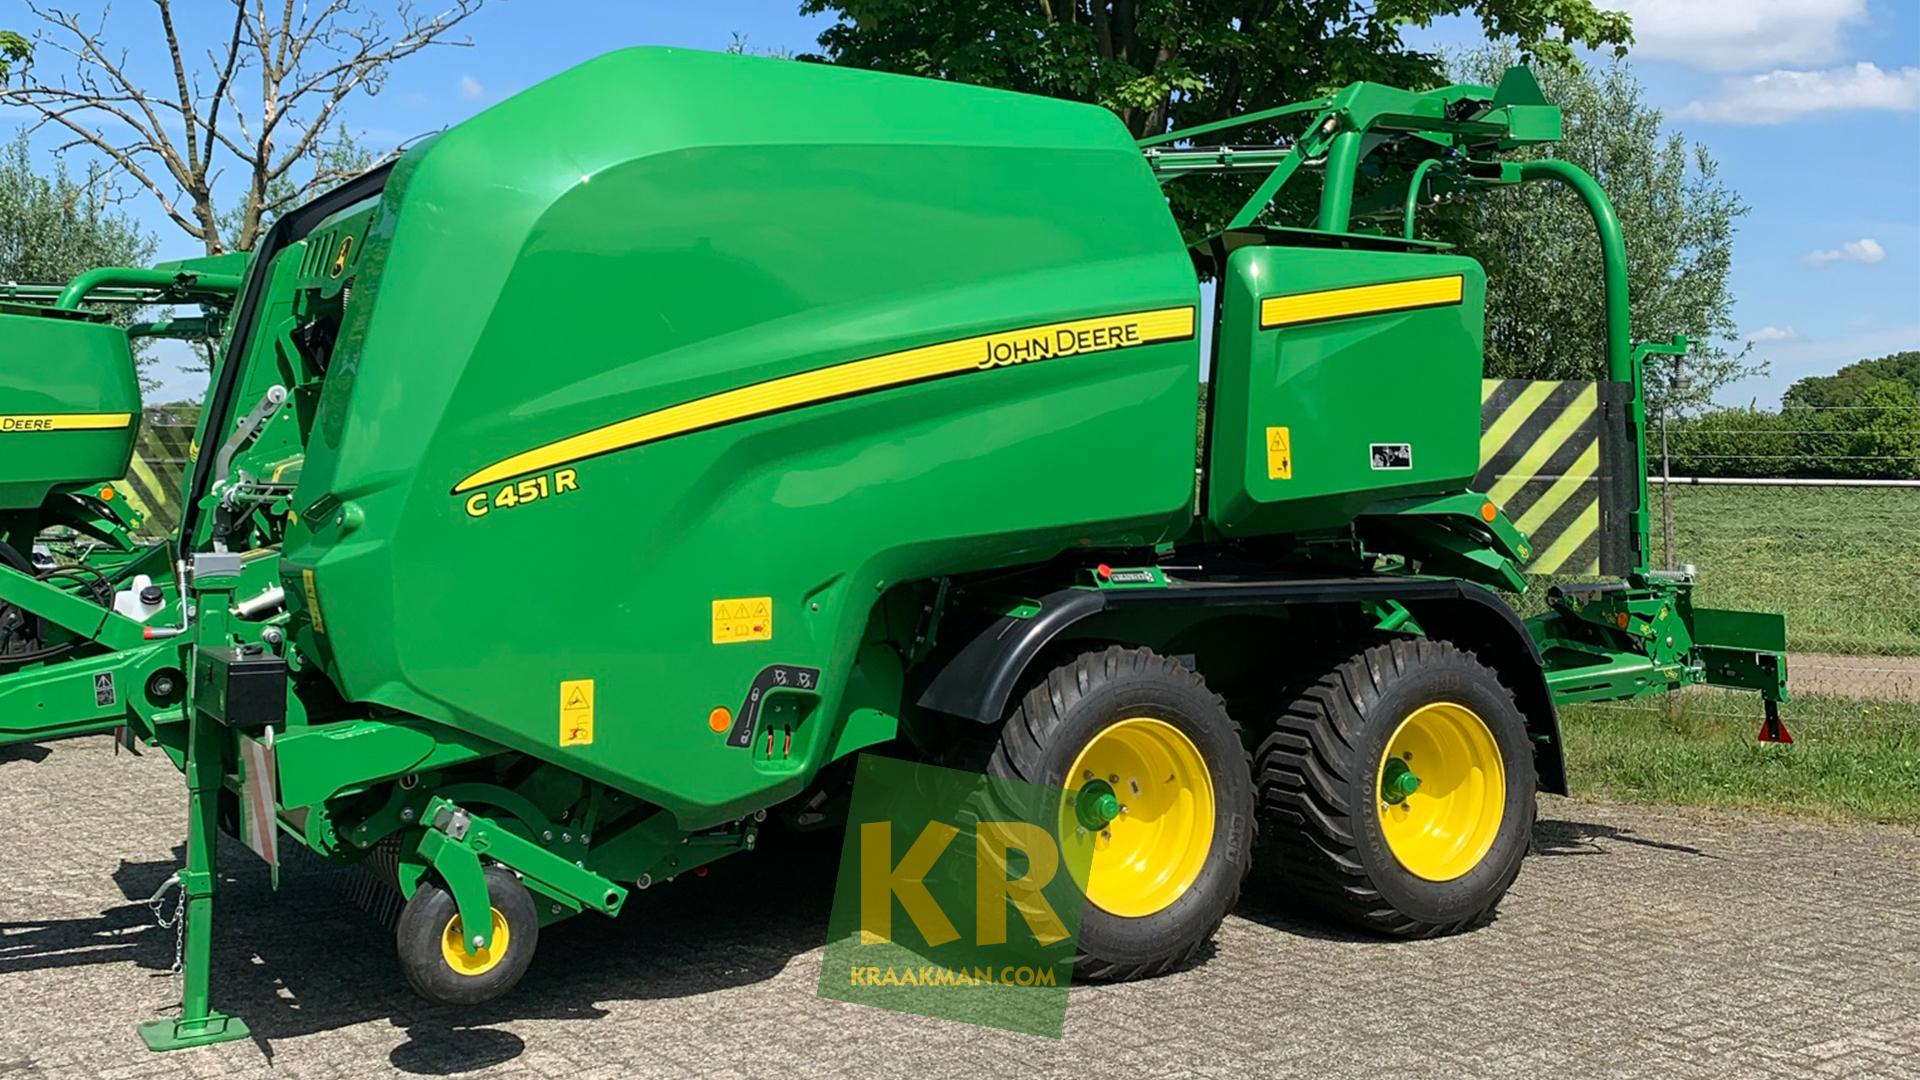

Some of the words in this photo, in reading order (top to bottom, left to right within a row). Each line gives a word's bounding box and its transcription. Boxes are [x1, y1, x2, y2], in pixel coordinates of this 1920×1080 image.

[979, 336, 1050, 366] JOHN
[1055, 323, 1140, 353] DEERE
[2, 417, 54, 430] DEERE
[466, 492, 490, 518] C
[494, 474, 549, 508] 451
[553, 468, 580, 495] R
